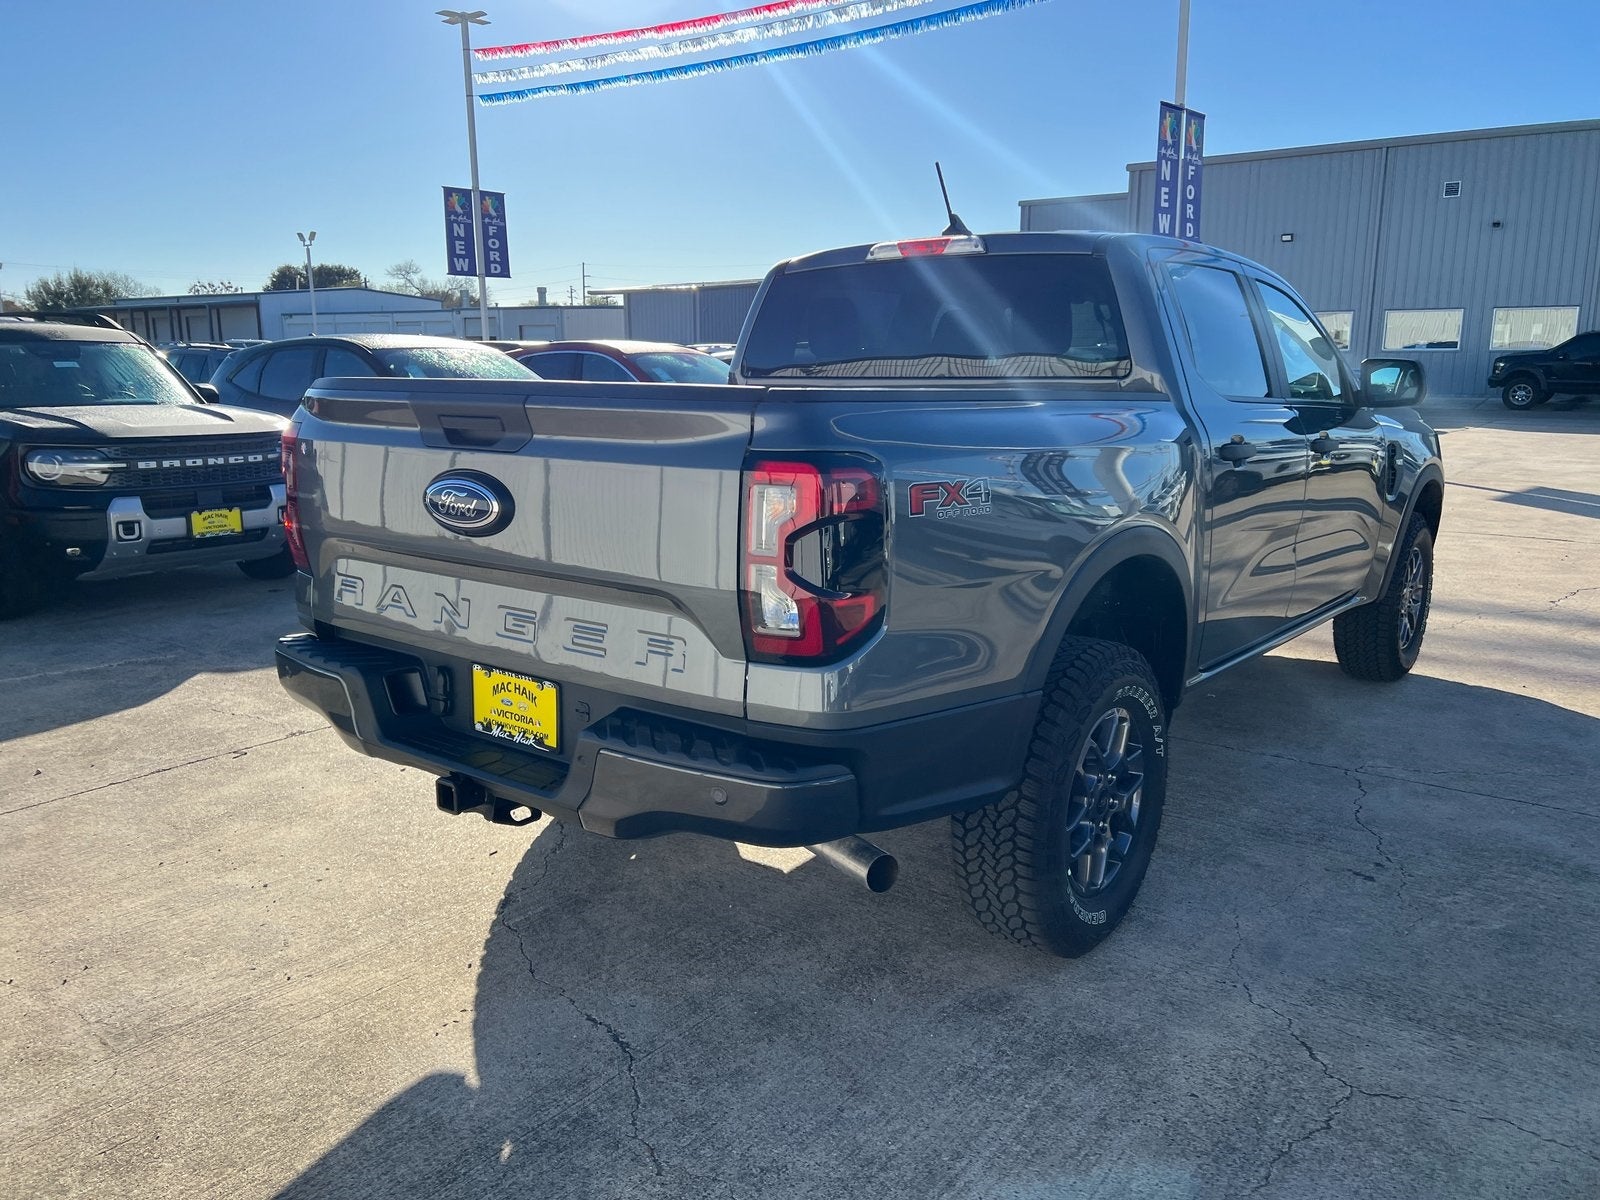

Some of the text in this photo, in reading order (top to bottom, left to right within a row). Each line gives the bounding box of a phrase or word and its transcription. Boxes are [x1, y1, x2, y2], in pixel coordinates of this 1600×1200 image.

[1158, 159, 1171, 234] NEW
[1185, 165, 1196, 238] FORD
[452, 223, 469, 272] NEW
[487, 225, 502, 274] FORD
[137, 454, 263, 469] BRONCO
[438, 489, 477, 518] Ford
[907, 477, 992, 518] FX4
[936, 505, 992, 520] OFF ROAD
[335, 571, 688, 674] RANGER
[492, 681, 512, 697] MAC
[514, 682, 538, 708] HAIK
[496, 708, 535, 727] VICTORIA
[488, 725, 542, 749] Mac Haik
[1152, 725, 1165, 758] A/T
